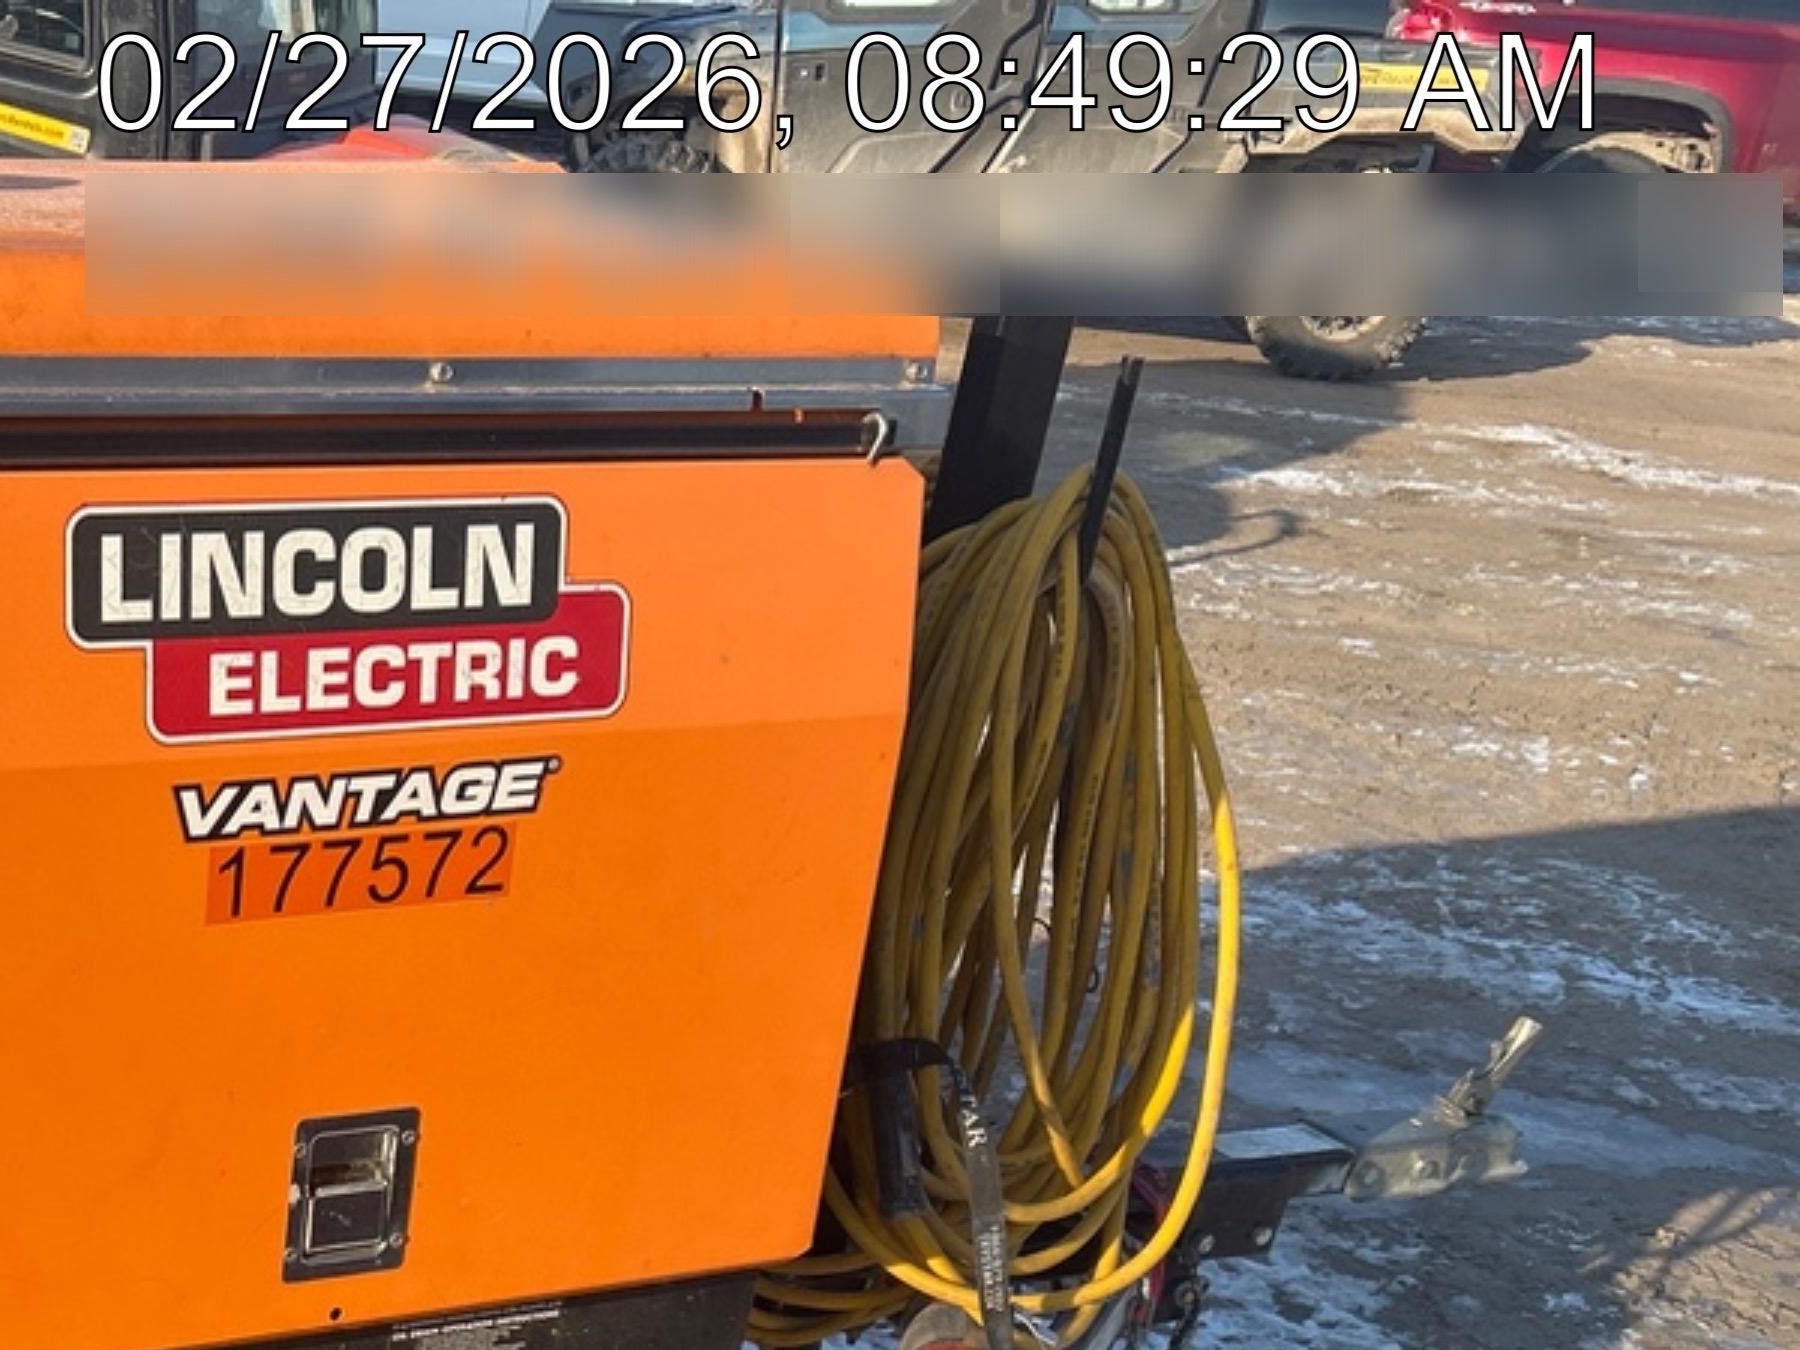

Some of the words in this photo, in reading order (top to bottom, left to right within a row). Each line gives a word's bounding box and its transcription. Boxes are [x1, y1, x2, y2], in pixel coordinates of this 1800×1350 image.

[101, 522, 536, 622] LINCOLN
[209, 635, 579, 716] ELECTRIC
[180, 760, 546, 838] VANTAGE
[218, 825, 509, 917] 177572
